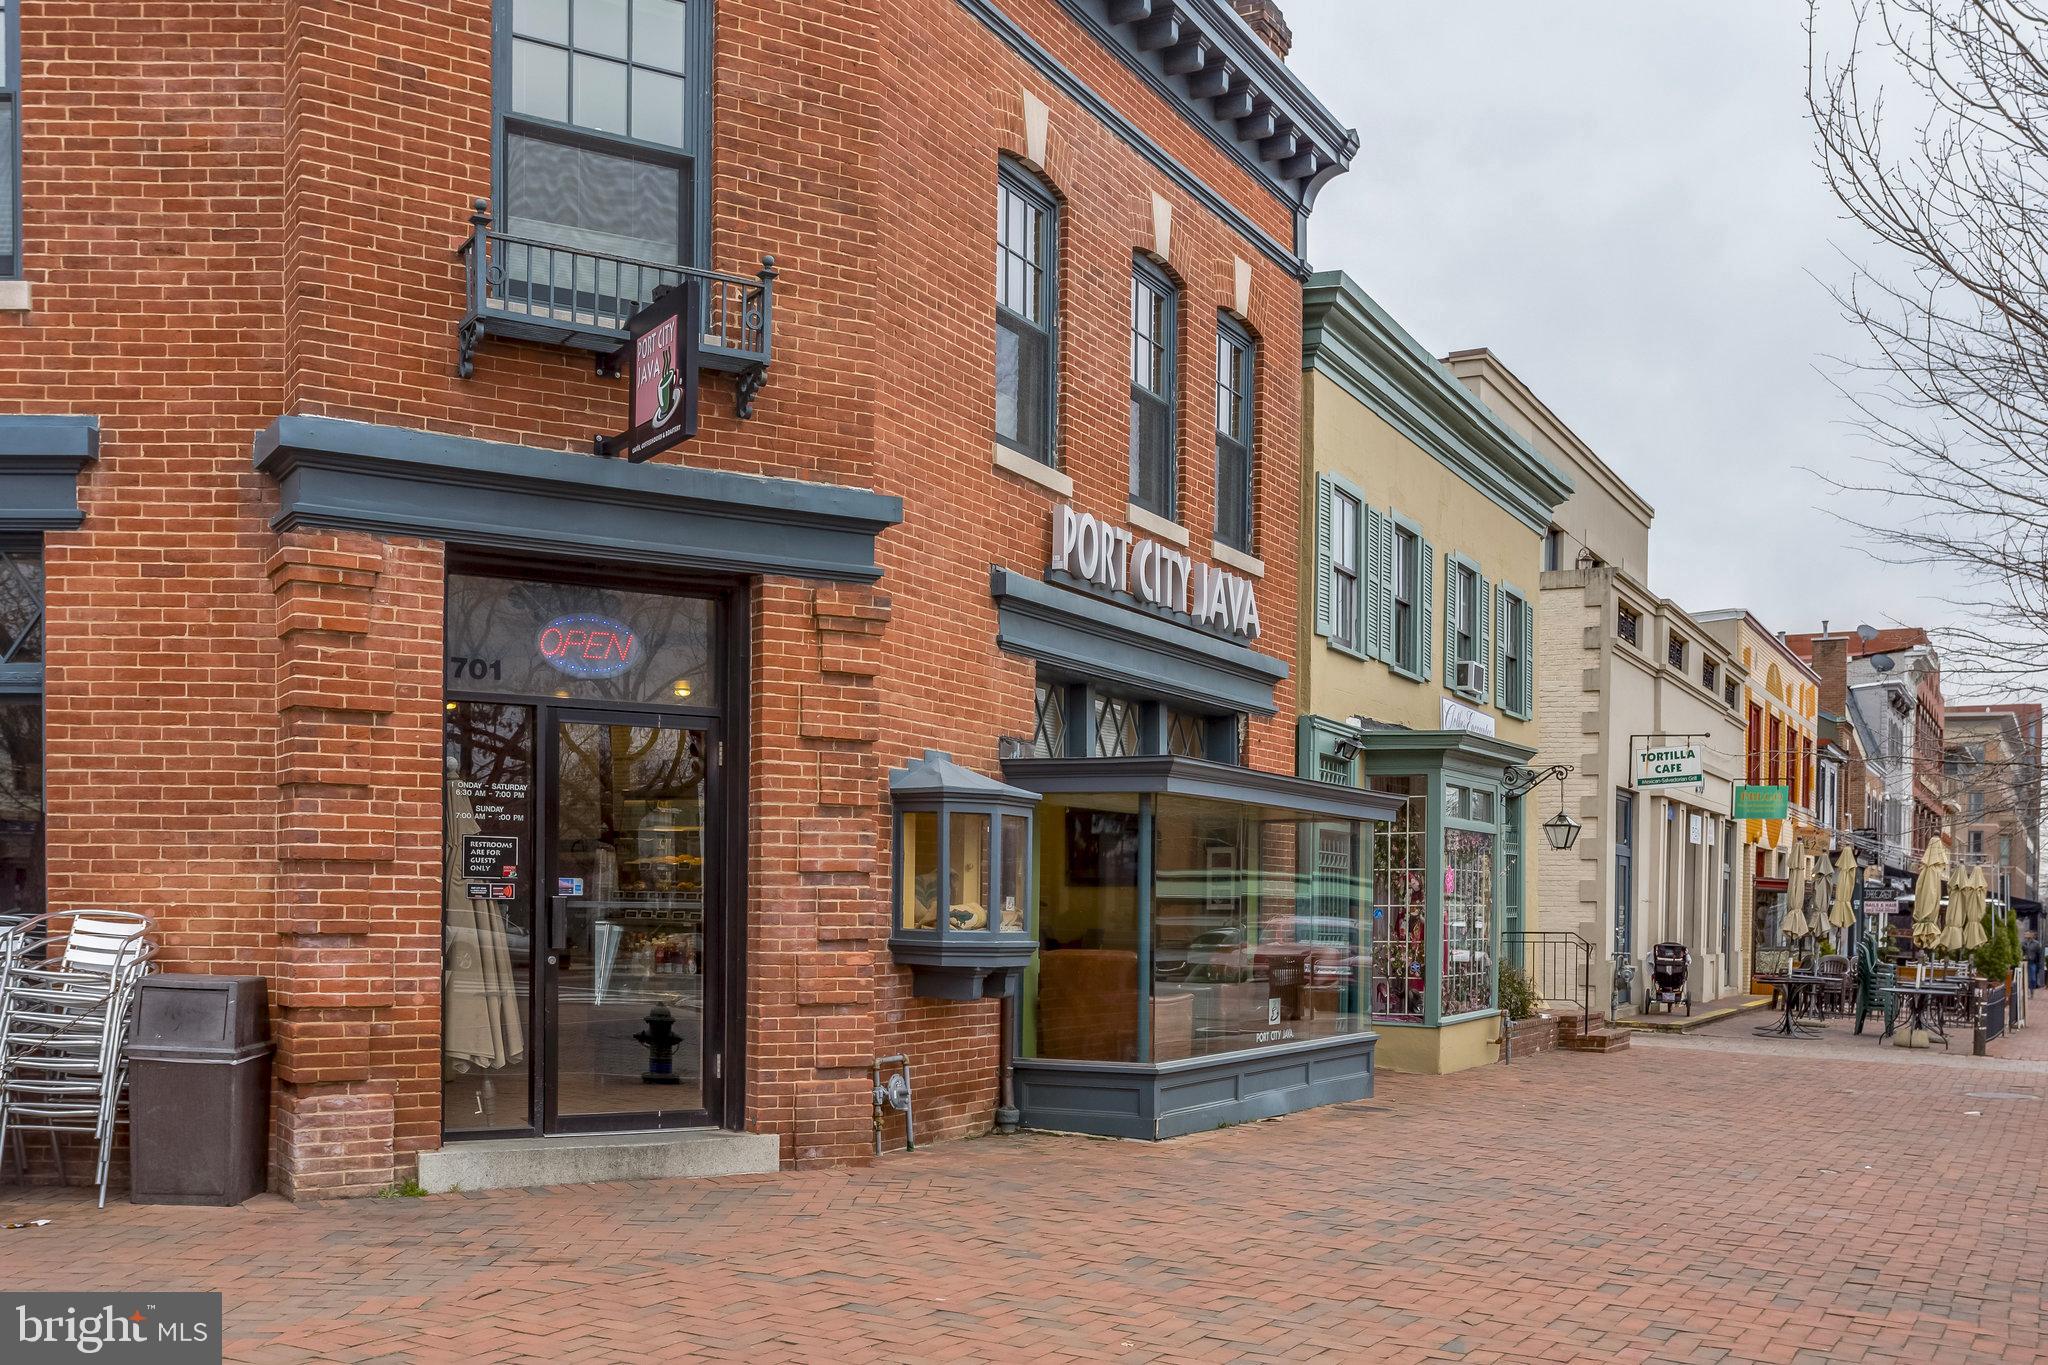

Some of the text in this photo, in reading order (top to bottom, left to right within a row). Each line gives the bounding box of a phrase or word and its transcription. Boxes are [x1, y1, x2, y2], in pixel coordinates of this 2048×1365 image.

[637, 321, 675, 361] PORT CITY
[637, 357, 660, 389] JAVA
[1052, 503, 1261, 639] PORT CITY JAVA
[539, 626, 634, 662] OPEN
[450, 656, 502, 681] 701
[1640, 749, 1696, 762] TORTILLA
[1655, 763, 1682, 774] CAFE
